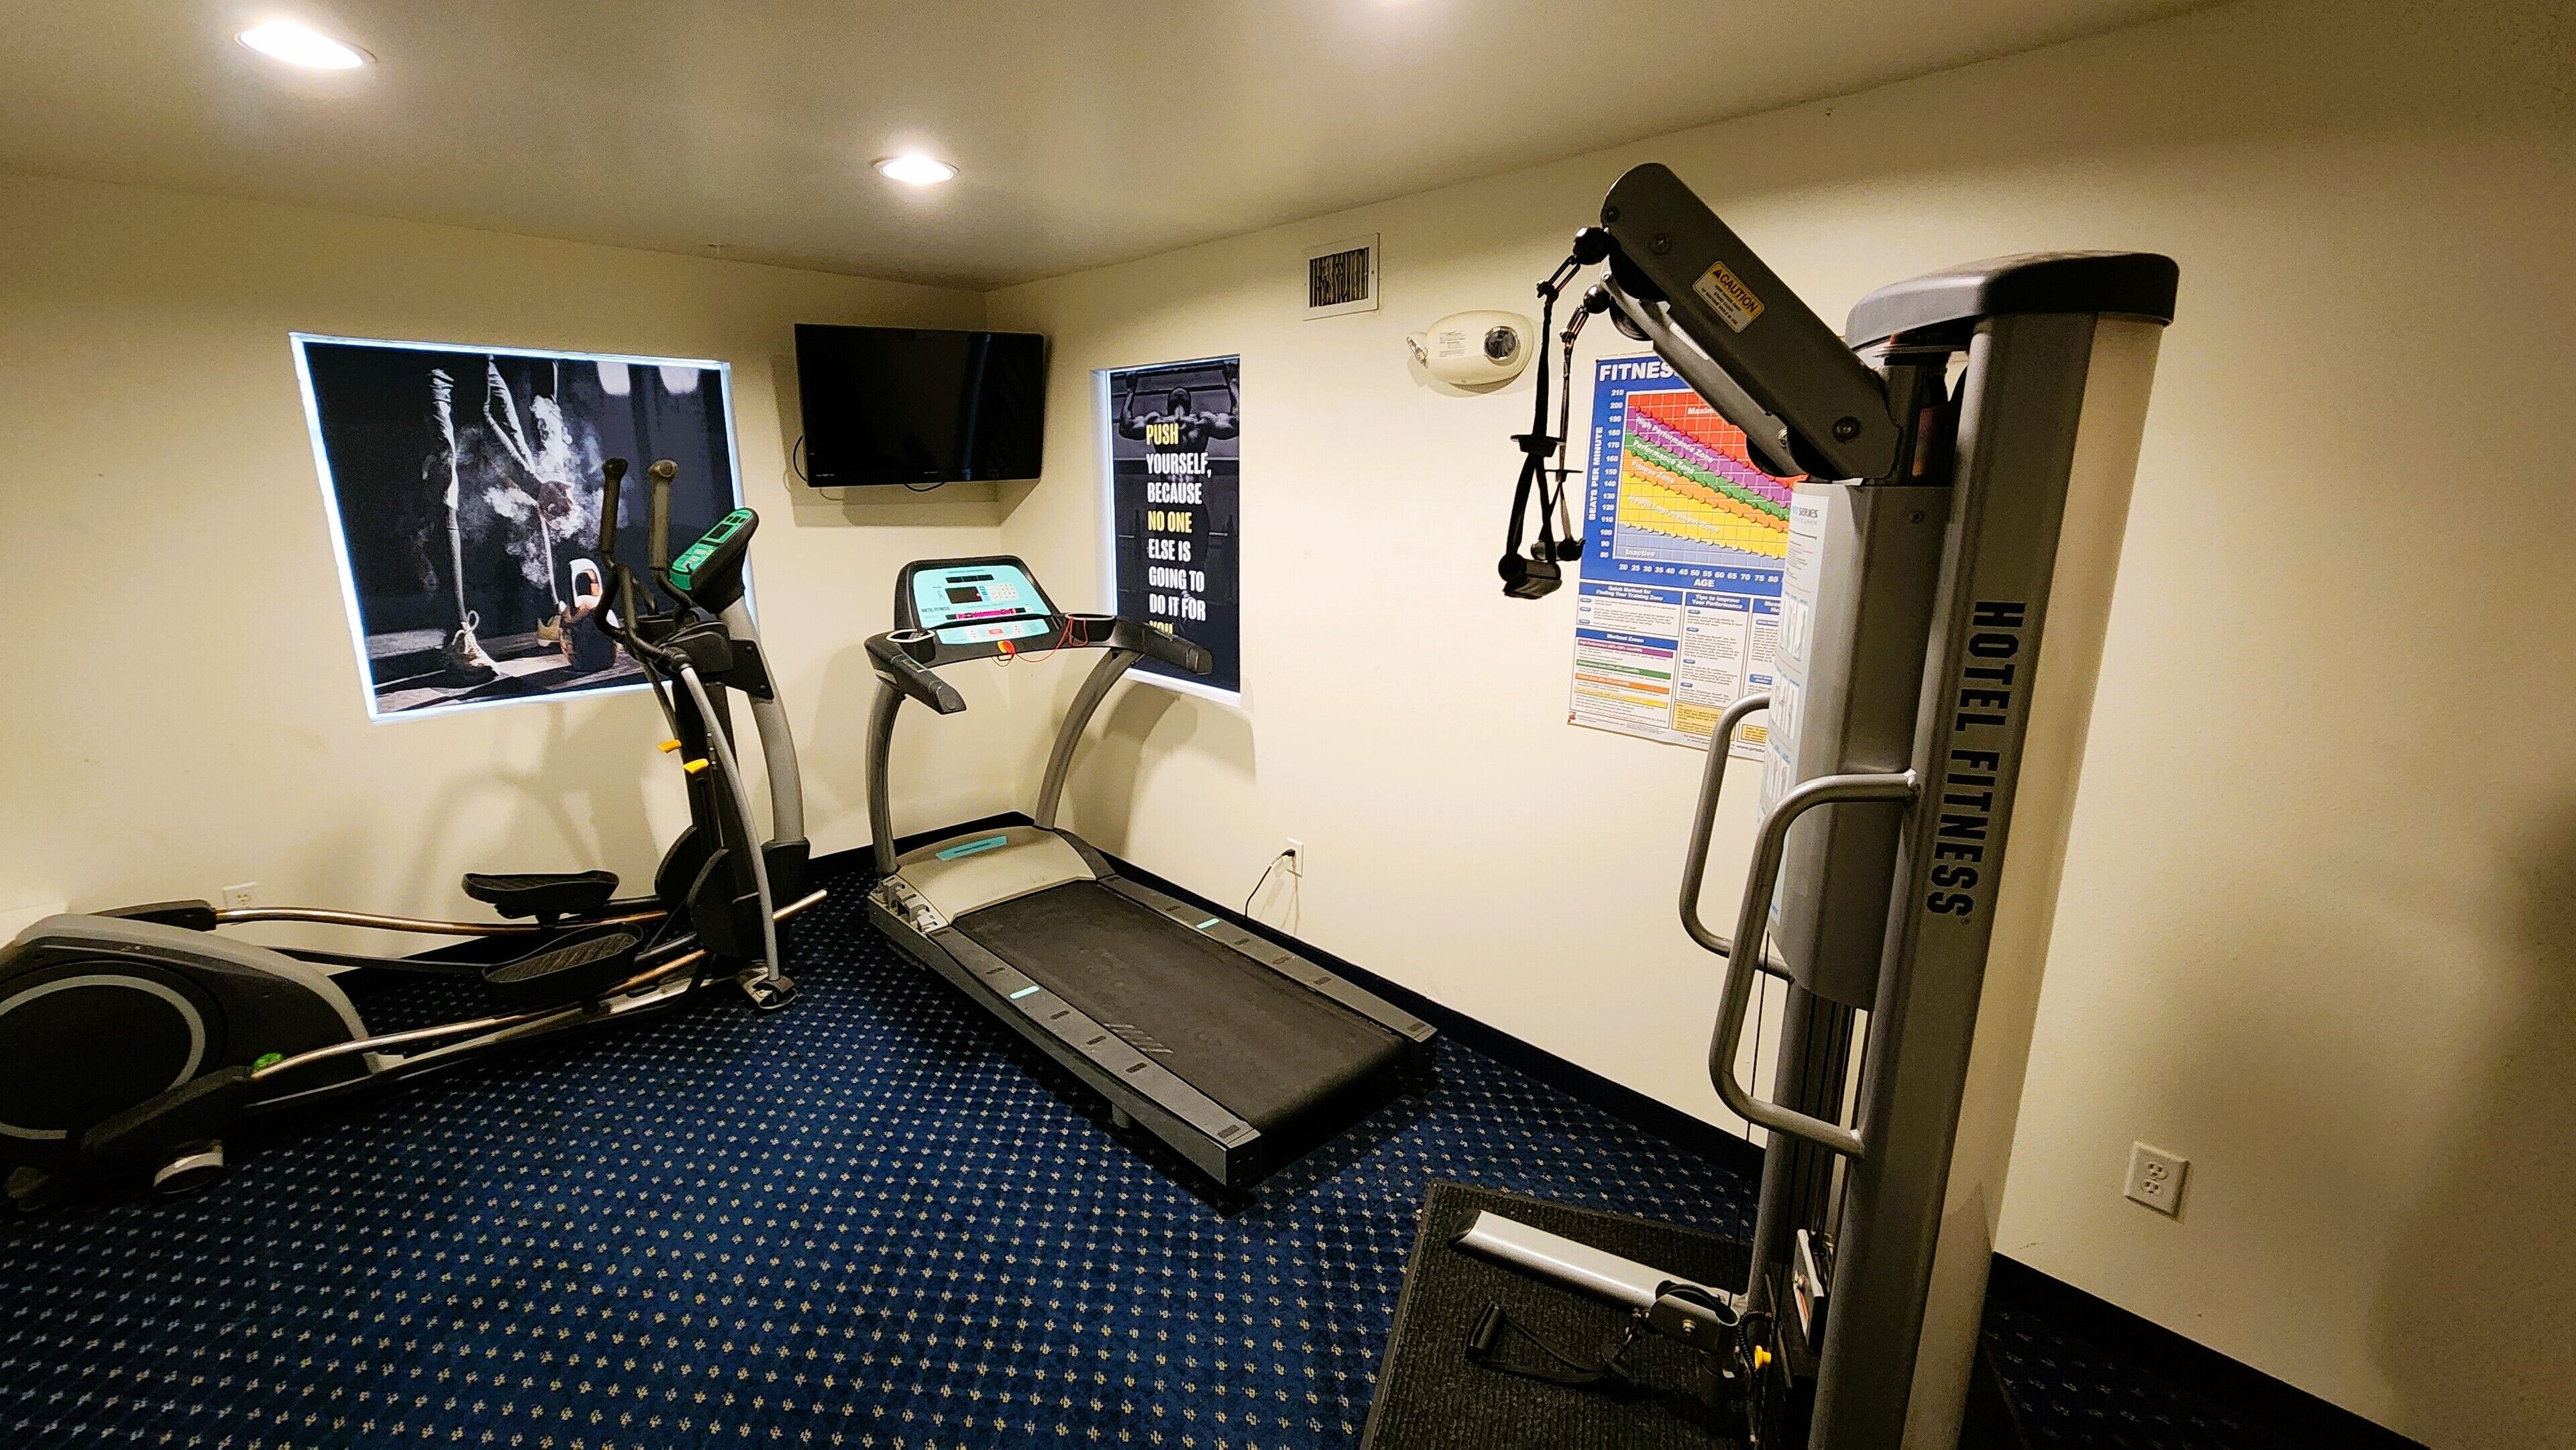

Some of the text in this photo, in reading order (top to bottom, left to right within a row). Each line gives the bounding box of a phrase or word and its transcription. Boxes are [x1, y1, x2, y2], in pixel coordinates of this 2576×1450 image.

[1719, 274, 1758, 313] CAUTION
[1599, 361, 1678, 381] FITNES
[1146, 423, 1179, 446] PUSH
[1635, 416, 1714, 463] High Performance Zone
[1146, 452, 1212, 478] YOURSELF,
[1633, 439, 1695, 474] Performance Zone
[1589, 427, 1603, 521] BEATS PER MINUTE
[1631, 460, 1675, 484] Fitness Zone
[1147, 482, 1202, 504] BECAUSE
[1147, 510, 1192, 533] NO ONE
[1628, 495, 1720, 533] Health Improvement Zone
[1148, 538, 1191, 562] ELSE IS
[1625, 549, 1656, 558] Inactive
[1148, 566, 1205, 592] GOING TO
[1693, 578, 1715, 587] AGE
[1740, 573, 1751, 581] 70
[1149, 593, 1206, 621] DO IT FOR
[1705, 601, 1743, 609] Performance
[1716, 595, 1741, 604] Improve
[1926, 601, 2027, 917] HOTEL FITNESS
